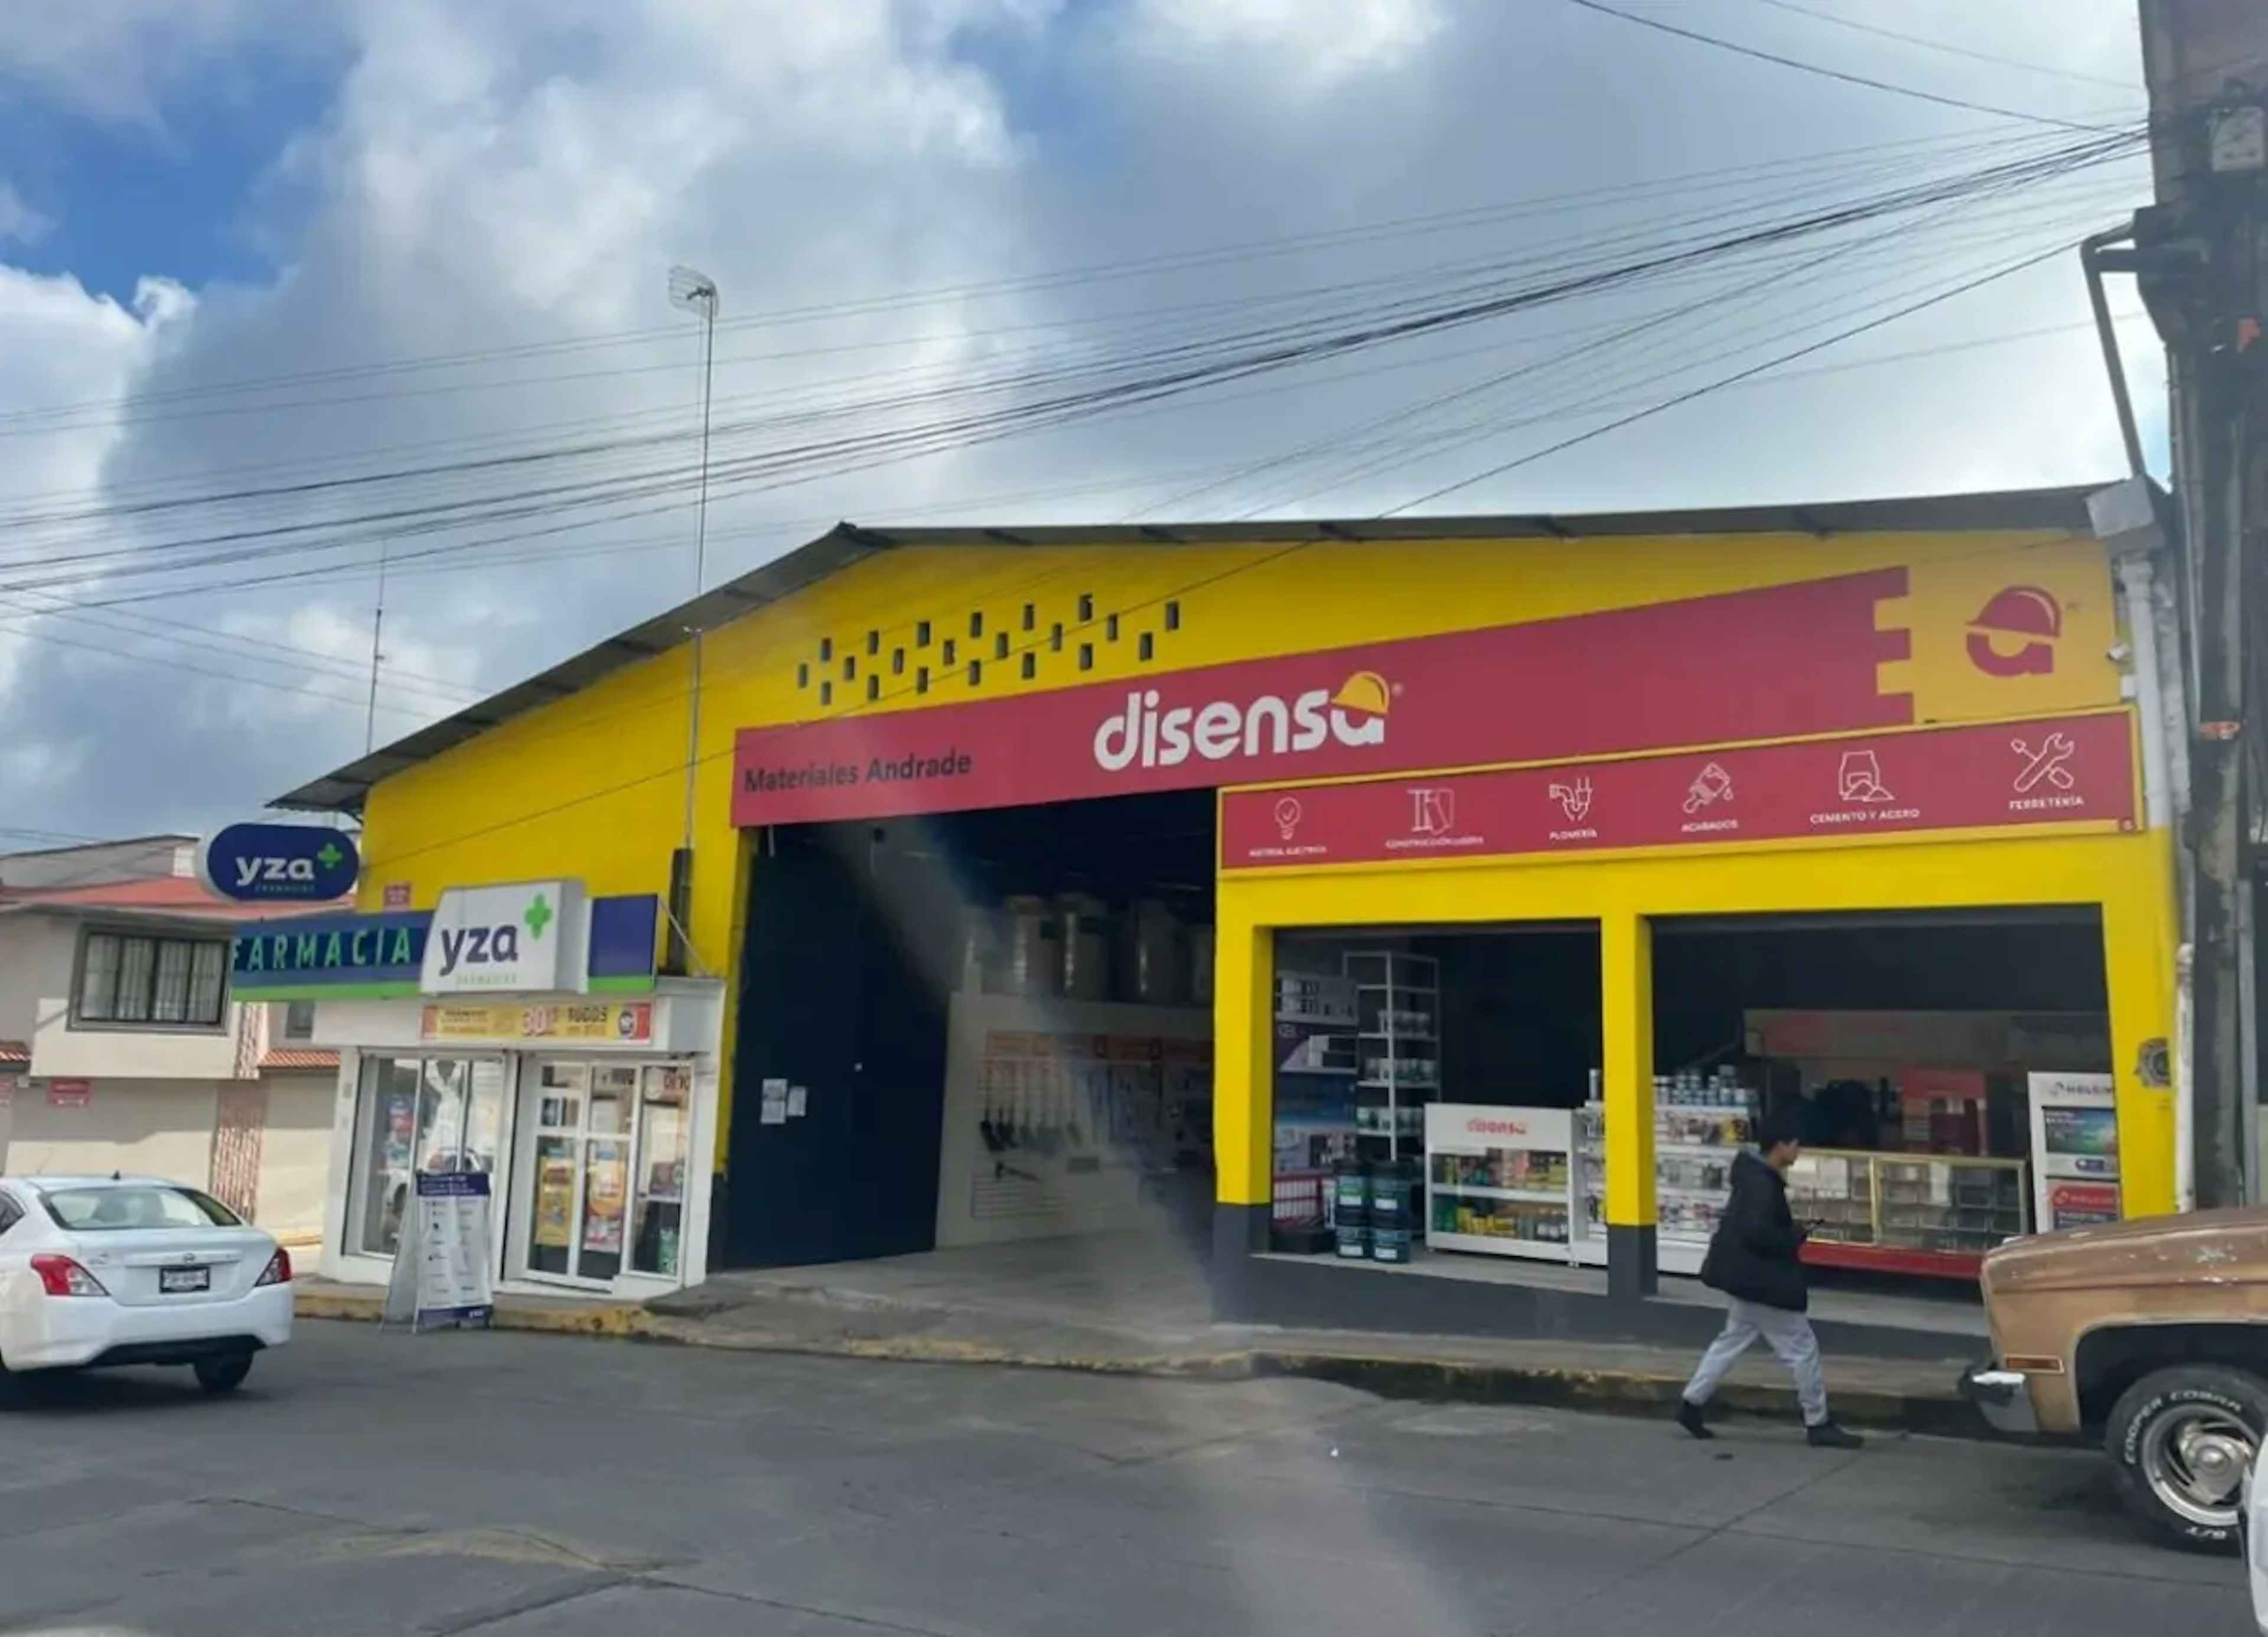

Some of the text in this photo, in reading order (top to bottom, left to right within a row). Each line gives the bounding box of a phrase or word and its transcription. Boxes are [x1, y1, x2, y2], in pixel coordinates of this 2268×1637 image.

[1094, 671, 1390, 770] disensa
[744, 747, 973, 793] Materiales Andrade
[1810, 808, 1920, 824] CEMENTO Y ACERO
[236, 857, 314, 886] yza
[230, 926, 412, 971] FARMACIA
[439, 924, 518, 977] yza
[2125, 1390, 2241, 1464] COOPER COBRA
